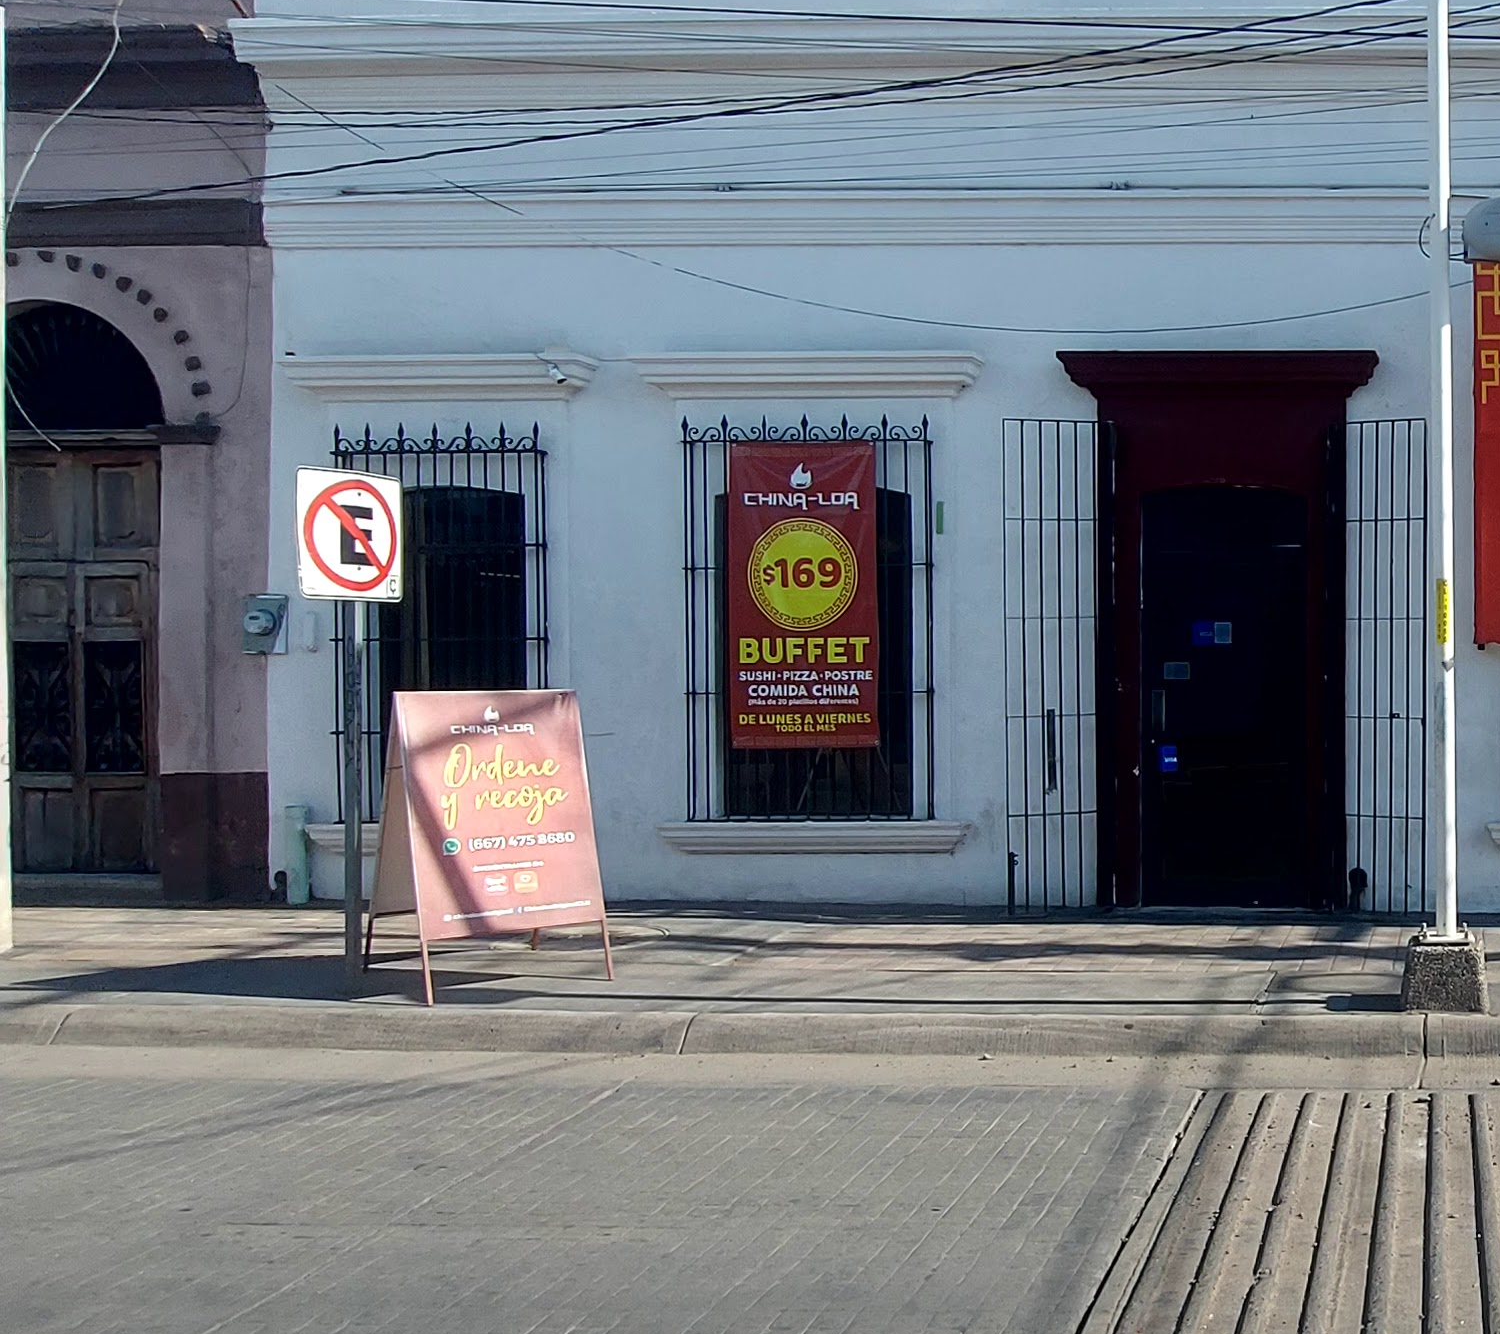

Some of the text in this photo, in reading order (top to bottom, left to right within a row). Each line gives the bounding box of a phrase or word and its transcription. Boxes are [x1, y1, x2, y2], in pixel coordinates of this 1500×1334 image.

[743, 492, 860, 510] CHINA-LOA
[762, 557, 842, 588] $169
[738, 637, 870, 664] BUFFET
[739, 670, 873, 681] SUSHI PIZZA POSTRE
[748, 683, 860, 697] COMIDA CHINA
[739, 713, 872, 725] DE LUNES A VIERNES
[776, 724, 836, 732] TODO EL MES
[450, 723, 536, 736] CHINA-LOA
[443, 742, 561, 789] Ordene
[440, 784, 569, 831] y recoja
[468, 831, 576, 852] (667) 475 8680
